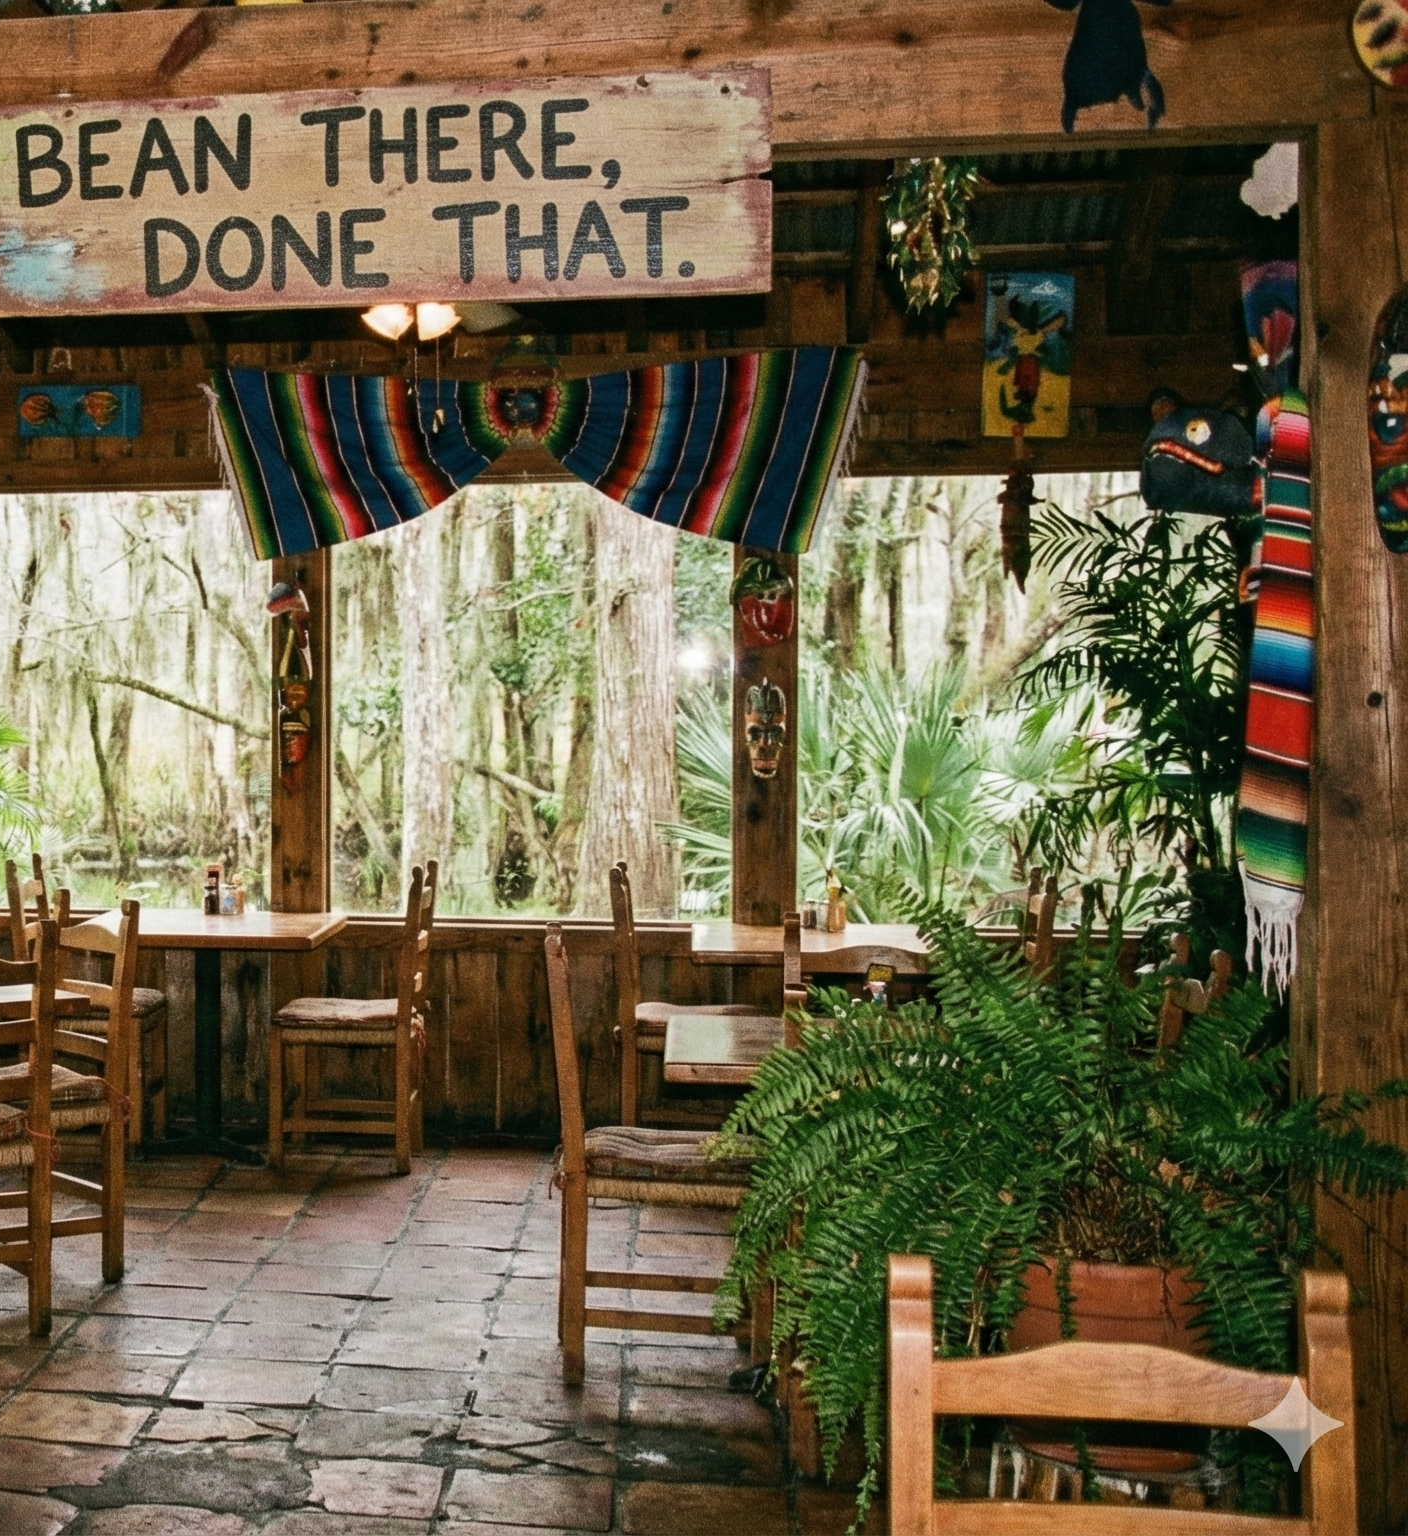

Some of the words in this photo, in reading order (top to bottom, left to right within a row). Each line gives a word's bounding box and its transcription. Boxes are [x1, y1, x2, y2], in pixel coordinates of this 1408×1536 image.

[15, 113, 252, 208] BEAN
[300, 98, 622, 190] THERE,
[143, 208, 390, 300] DONE
[432, 196, 697, 286] THAT.
